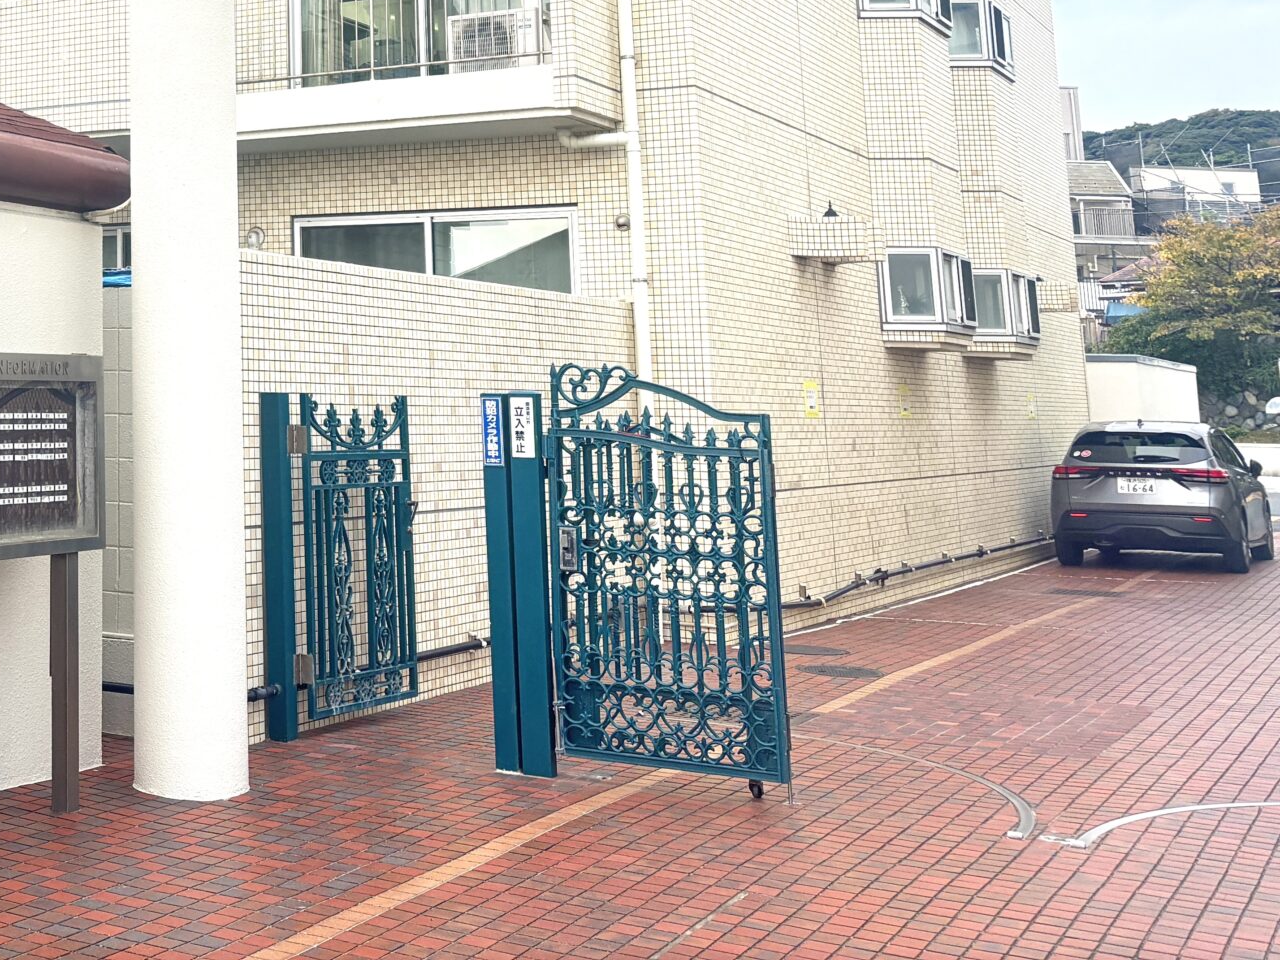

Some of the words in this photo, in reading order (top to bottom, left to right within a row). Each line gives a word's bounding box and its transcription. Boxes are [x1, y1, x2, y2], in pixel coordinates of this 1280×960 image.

[485, 400, 499, 458] 防犯カメラ作動中
[514, 406, 526, 453] 立入禁止
[1126, 483, 1154, 492] 16-64
